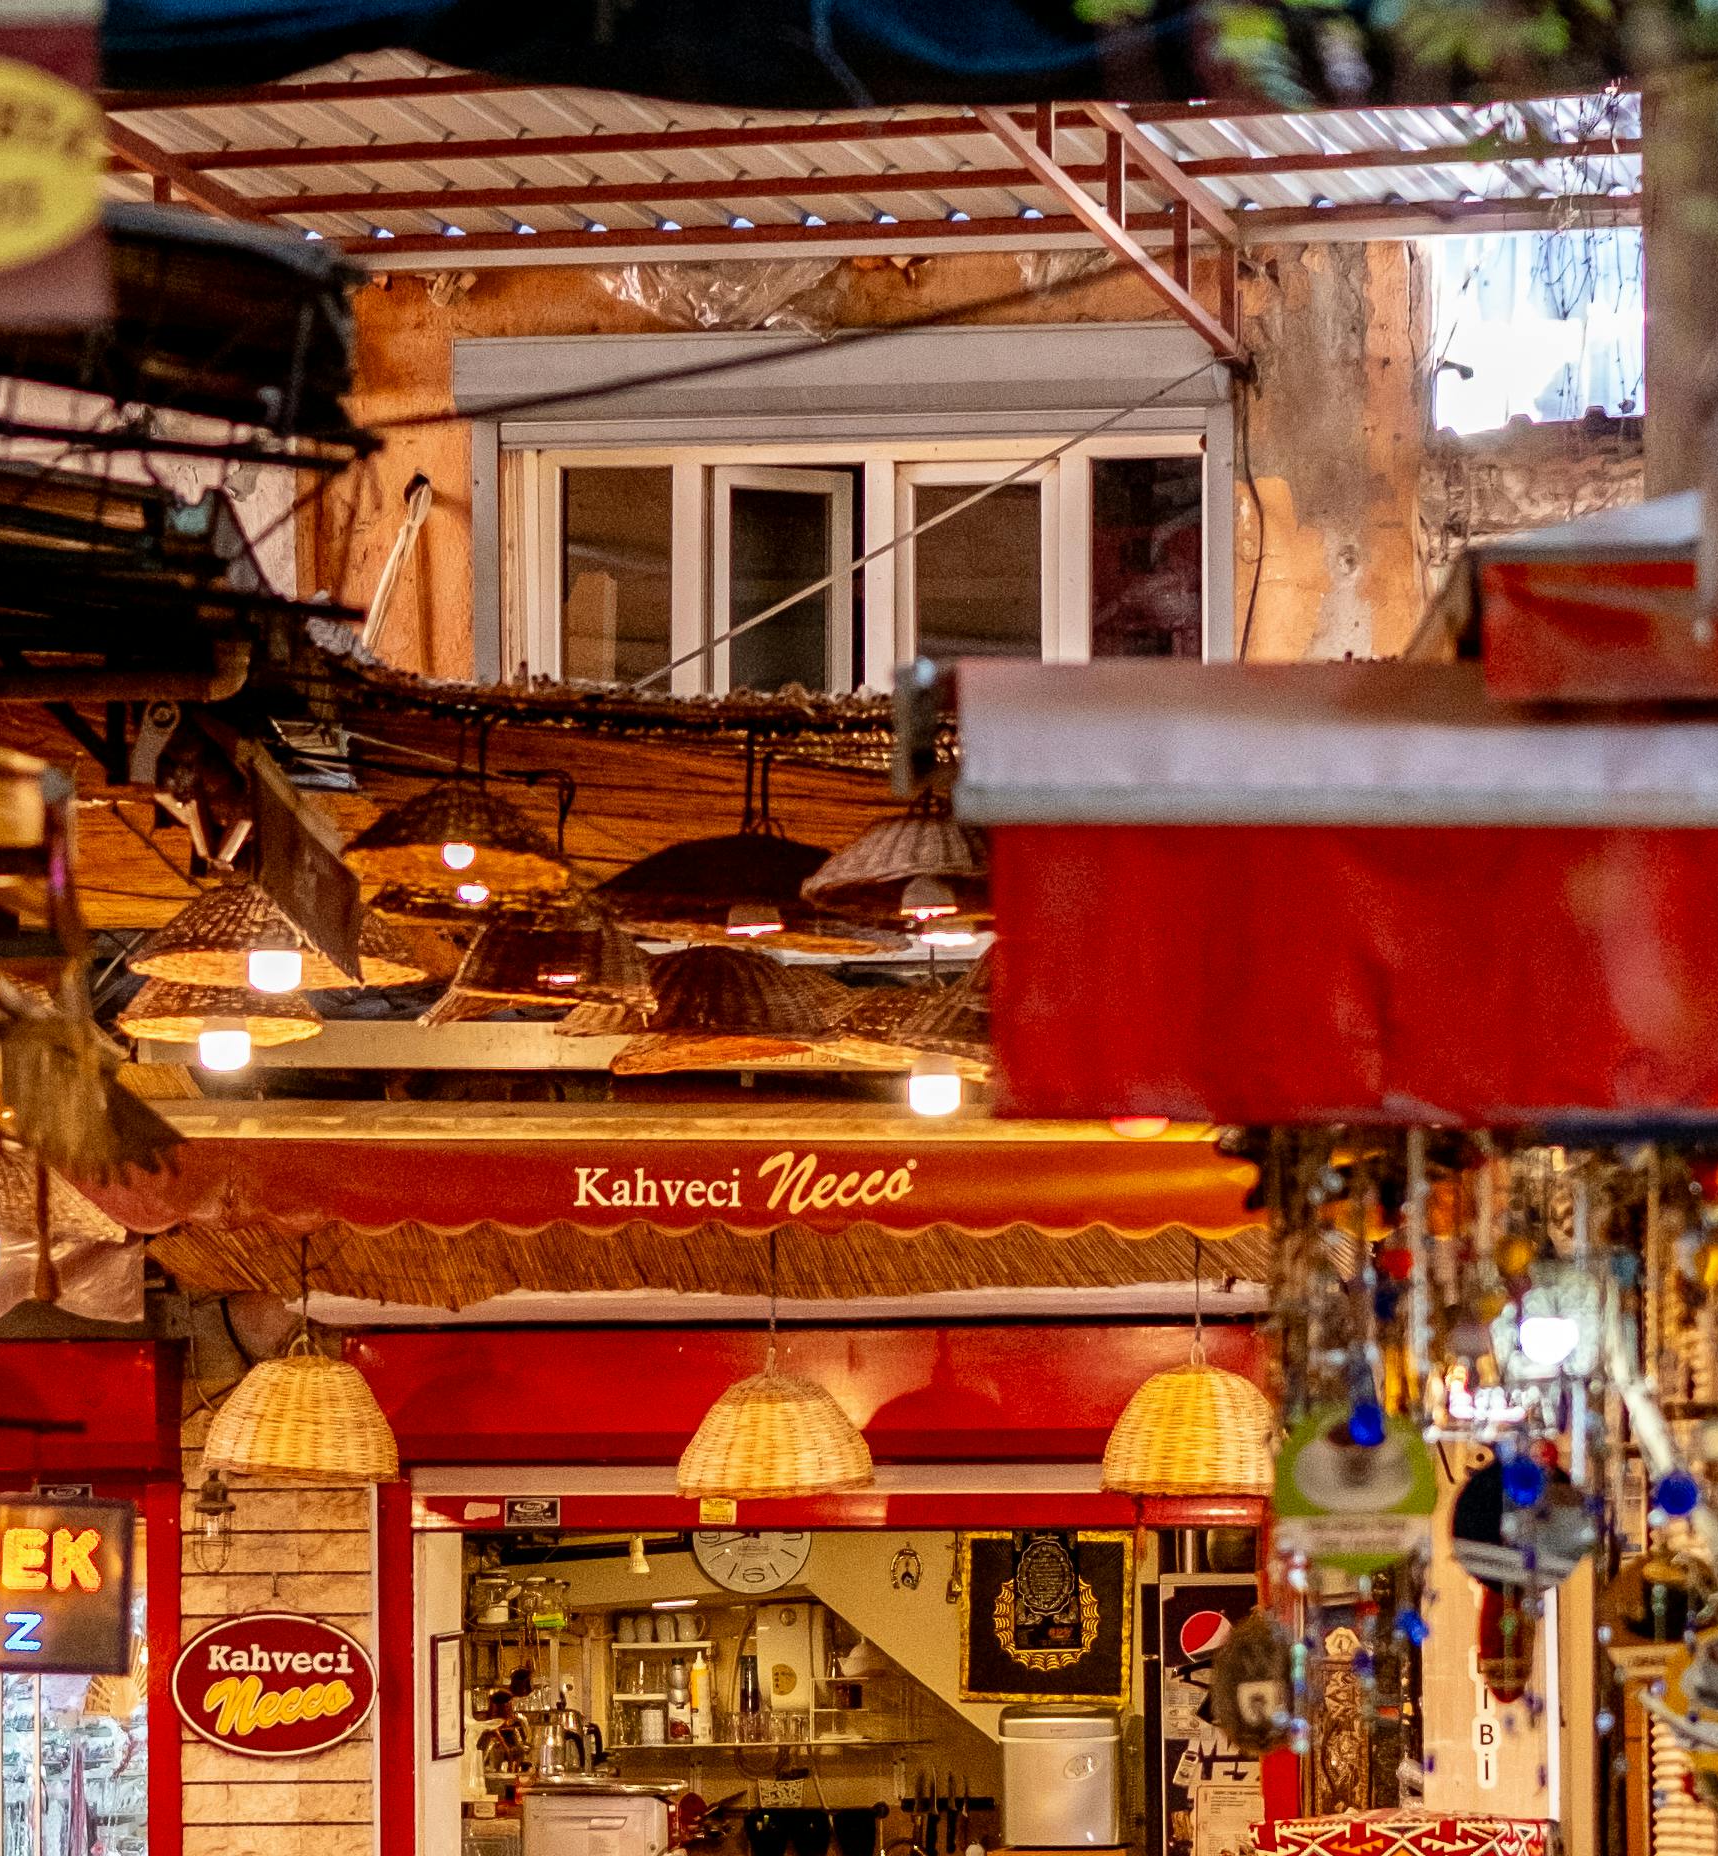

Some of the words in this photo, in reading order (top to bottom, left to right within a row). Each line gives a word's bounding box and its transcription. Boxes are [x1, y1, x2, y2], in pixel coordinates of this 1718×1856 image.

[573, 1167, 742, 1208] Kahveci
[757, 1151, 915, 1214] Necco
[206, 1643, 355, 1674] Kahveci
[203, 1675, 355, 1736] Necco
